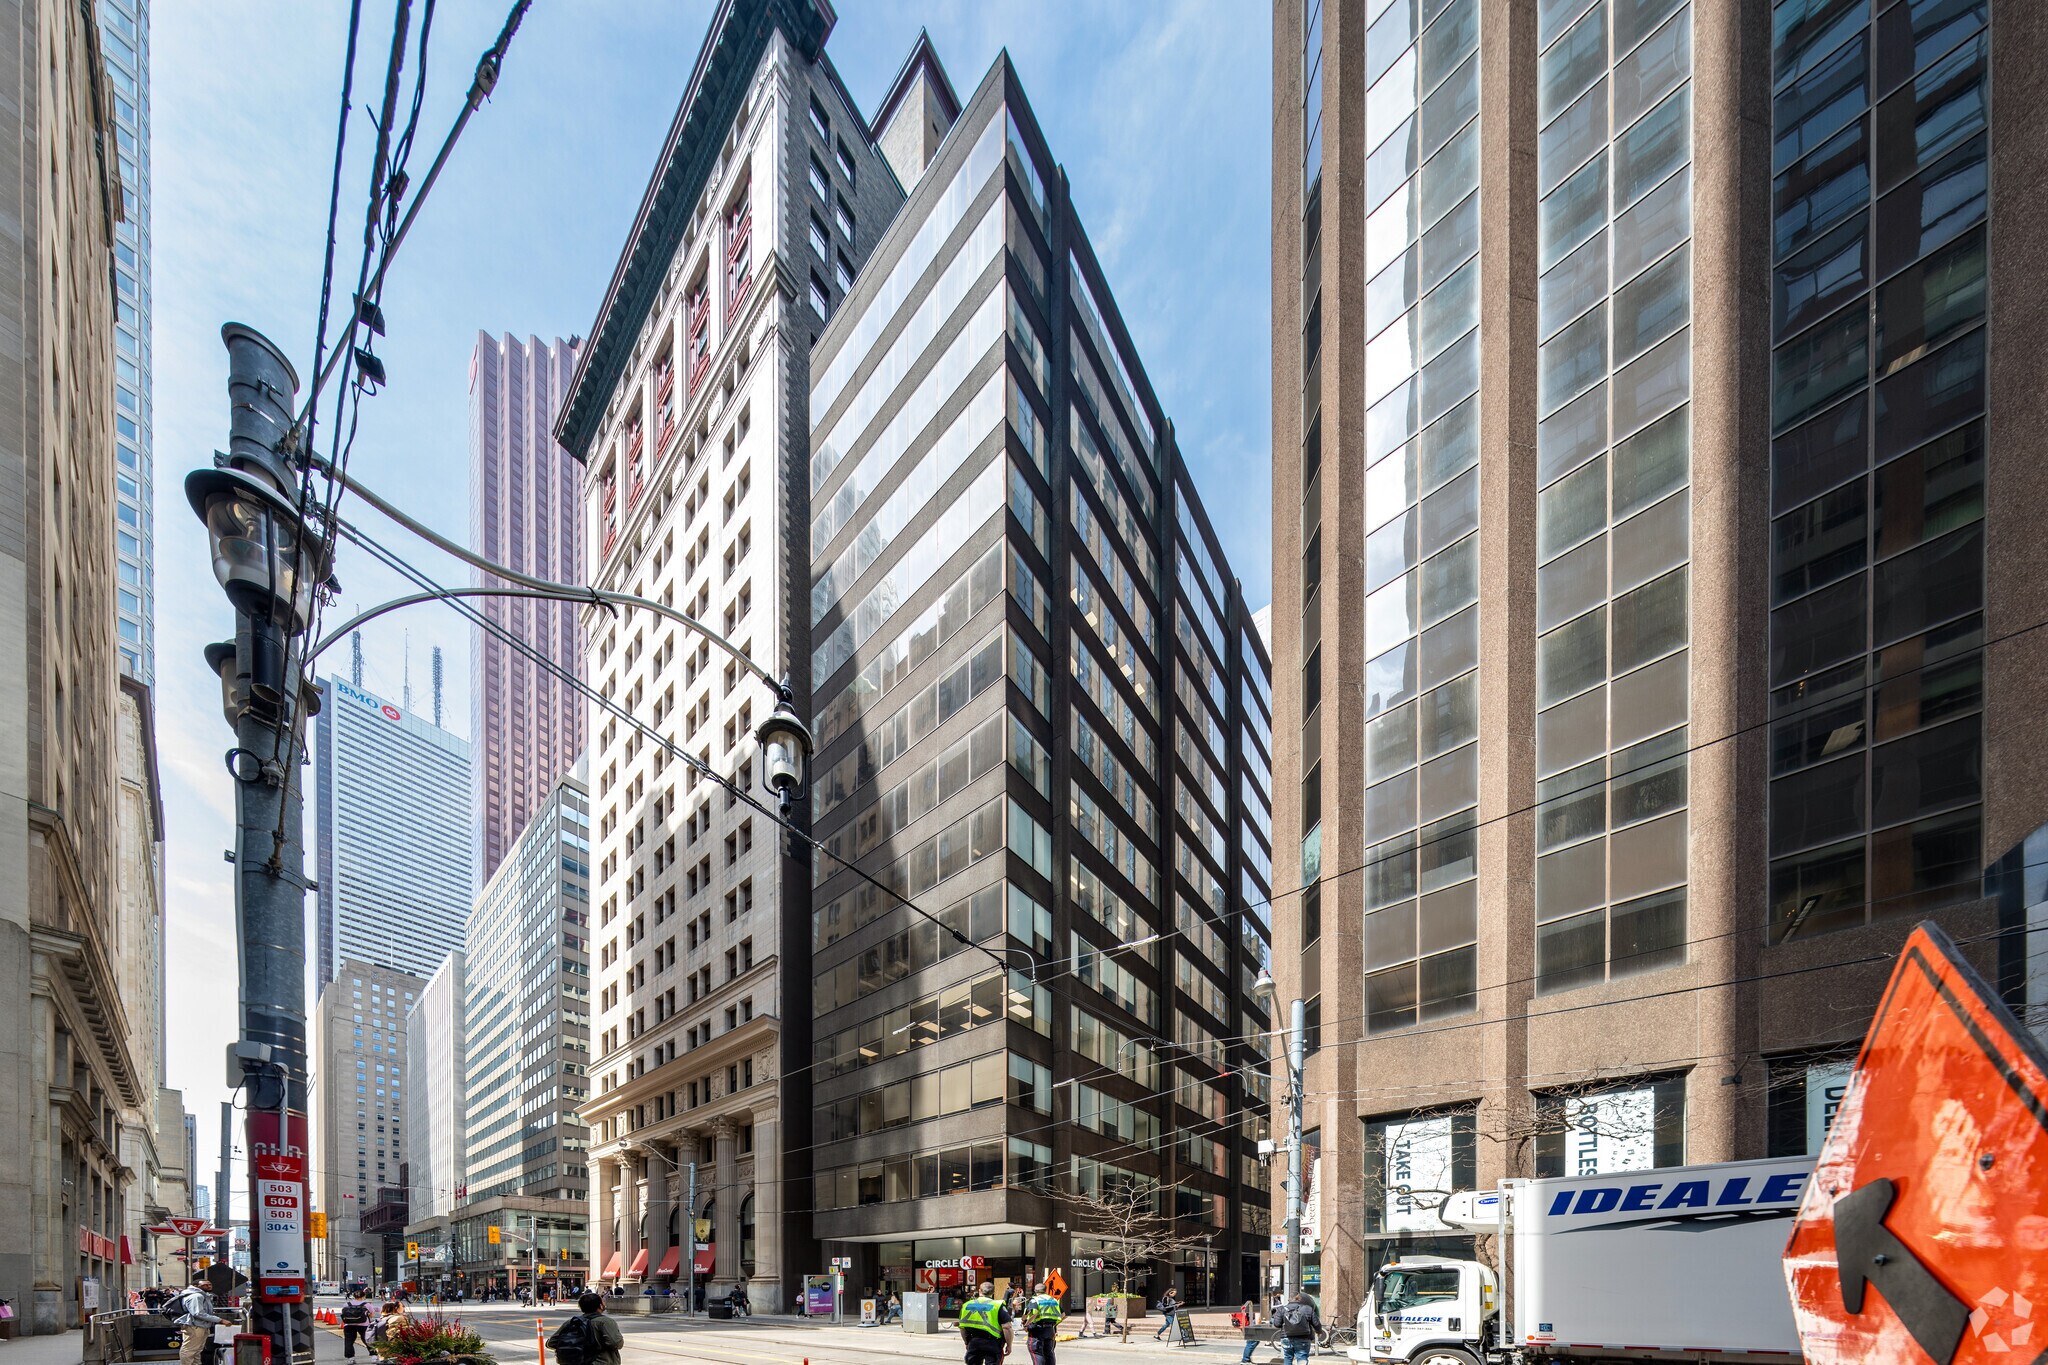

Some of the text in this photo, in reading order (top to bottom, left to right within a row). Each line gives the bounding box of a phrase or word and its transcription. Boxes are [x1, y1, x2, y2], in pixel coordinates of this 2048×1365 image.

[337, 682, 378, 708] BMO
[1578, 1103, 1598, 1176] BOTTLES
[1395, 1140, 1411, 1181] TAKE
[270, 1184, 292, 1193] 503
[270, 1197, 292, 1206] 504
[1396, 1184, 1412, 1215] OUT
[270, 1210, 293, 1218] 508
[267, 1223, 288, 1231] 304
[925, 1258, 972, 1269] CIRCLE K
[1071, 1259, 1094, 1268] CIRCLE
[920, 1269, 936, 1285] K
[1388, 1315, 1443, 1323] IDEALEASE
